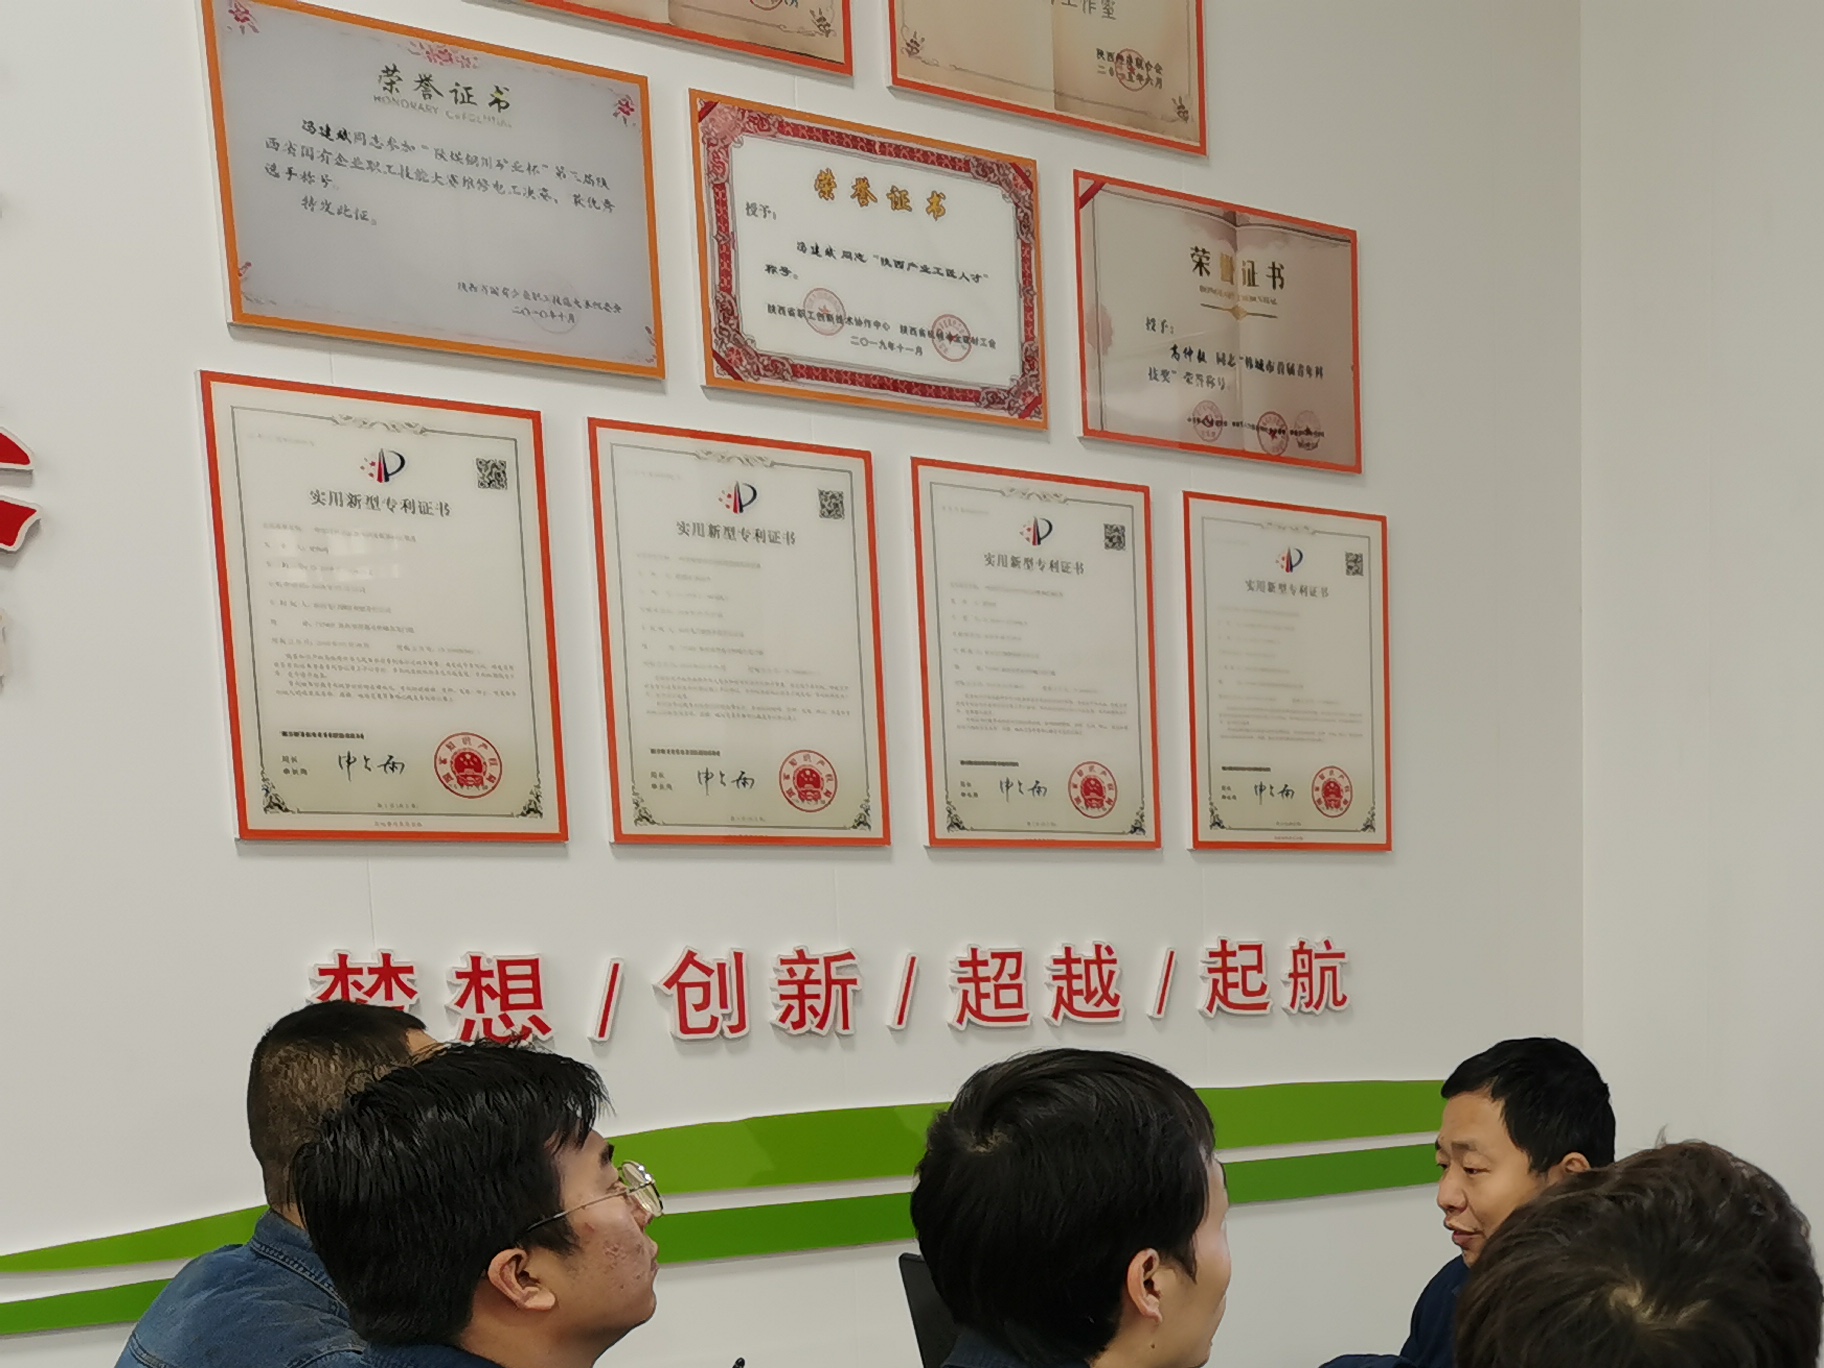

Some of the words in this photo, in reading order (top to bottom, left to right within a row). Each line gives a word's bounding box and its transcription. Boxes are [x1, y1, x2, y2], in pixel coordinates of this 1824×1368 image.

[378, 64, 510, 113] 荣誉证书
[814, 168, 946, 220] 荣誉证书
[309, 489, 452, 518] 实用新型专利证书
[676, 521, 796, 546] 实用新型专利证书
